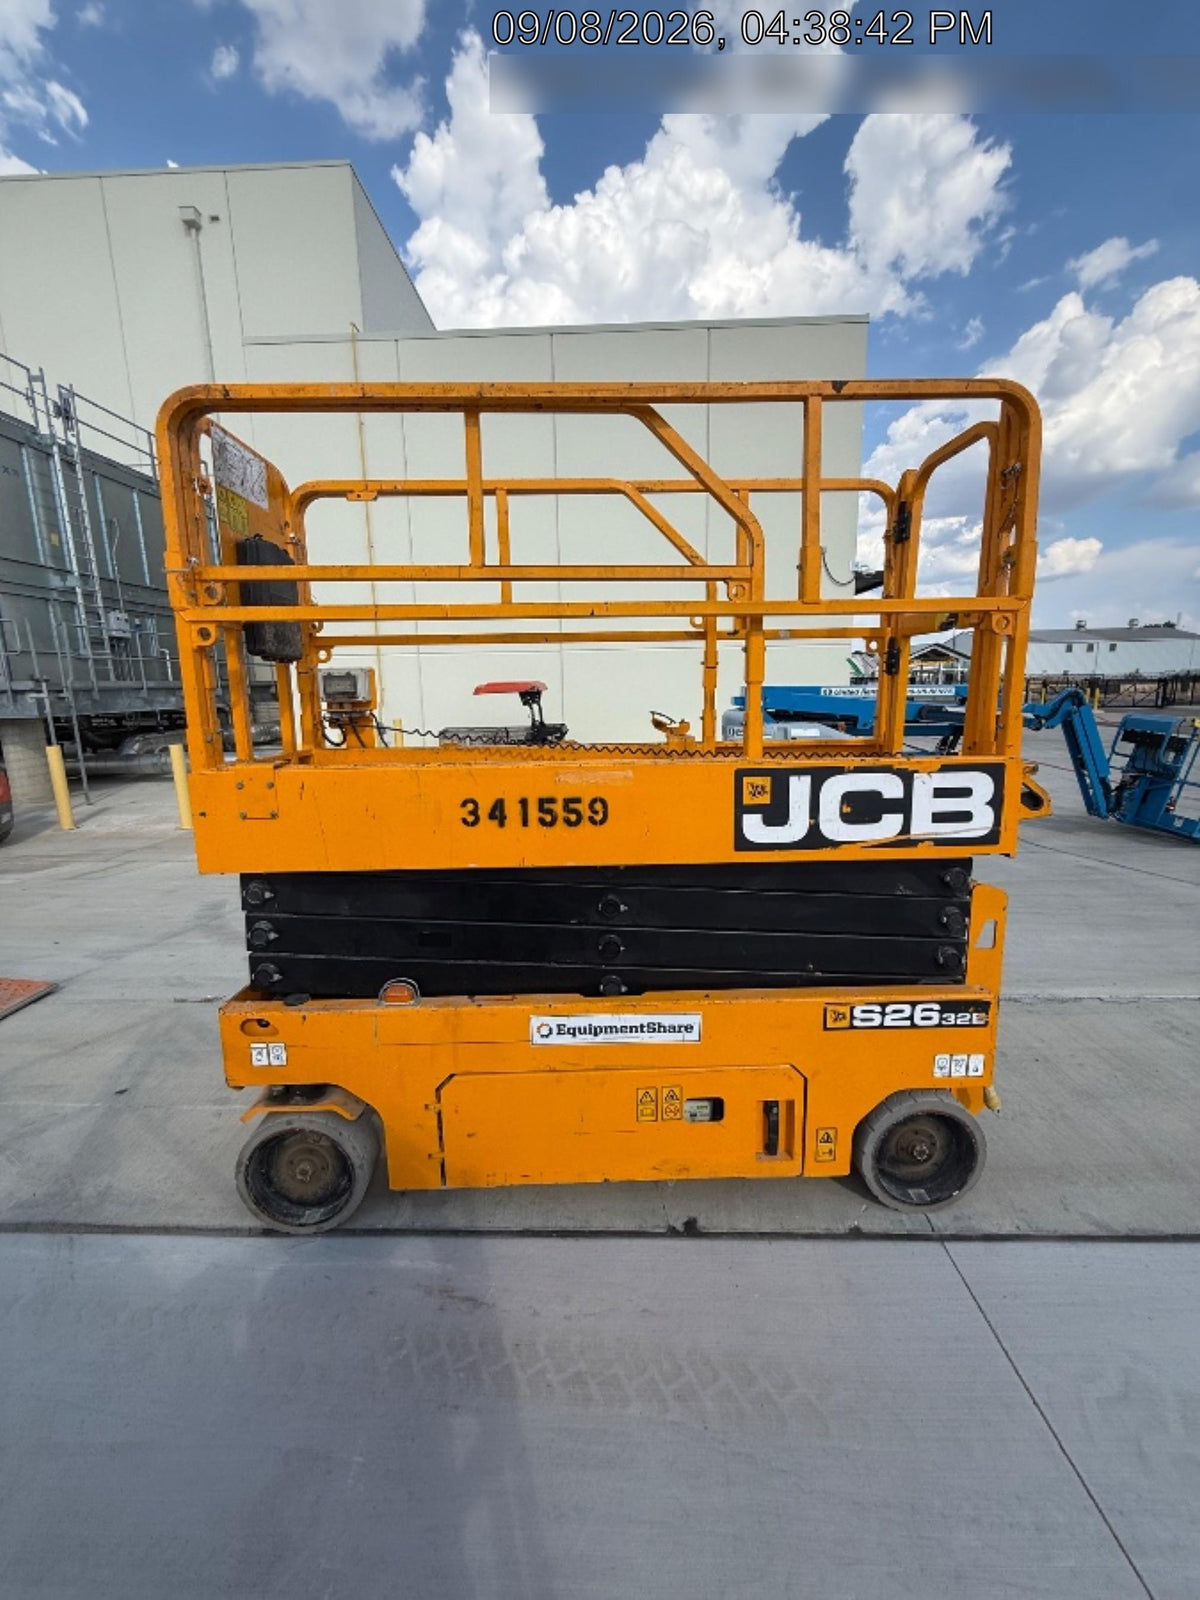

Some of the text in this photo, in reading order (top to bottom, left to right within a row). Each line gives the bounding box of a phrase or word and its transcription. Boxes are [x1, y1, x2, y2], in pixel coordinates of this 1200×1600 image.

[459, 796, 610, 828] 341559
[742, 771, 996, 844] JCB
[556, 1021, 694, 1038] EquipmentShare
